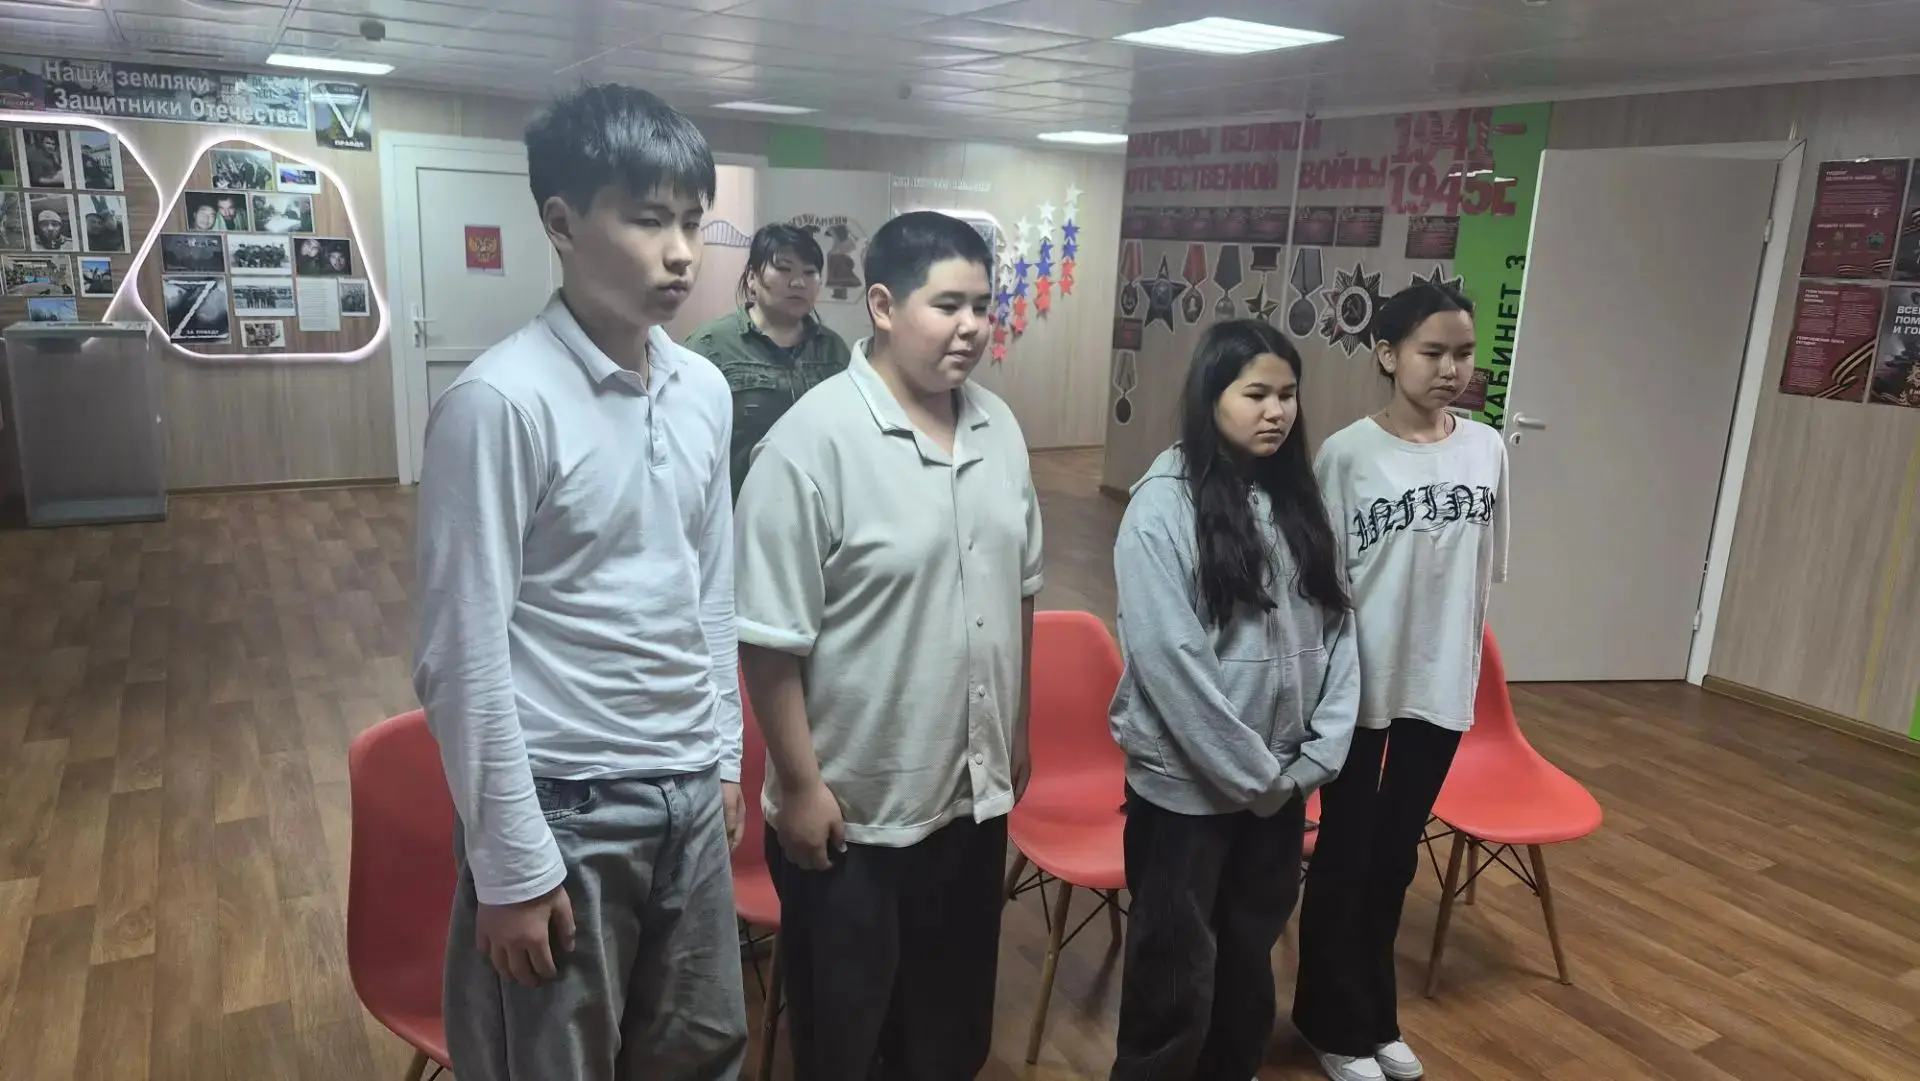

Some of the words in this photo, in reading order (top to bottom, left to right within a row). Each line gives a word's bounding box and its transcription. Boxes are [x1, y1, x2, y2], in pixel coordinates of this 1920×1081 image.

[44, 60, 108, 84] Наши
[116, 70, 211, 93] земляки
[54, 88, 183, 115] Защитники
[190, 98, 300, 125] Отечества
[1300, 150, 1388, 190] ВОЙНЫ
[1484, 283, 1522, 430] КАБИНЕТ
[1505, 254, 1527, 270] 3
[1892, 326, 1901, 334] И
